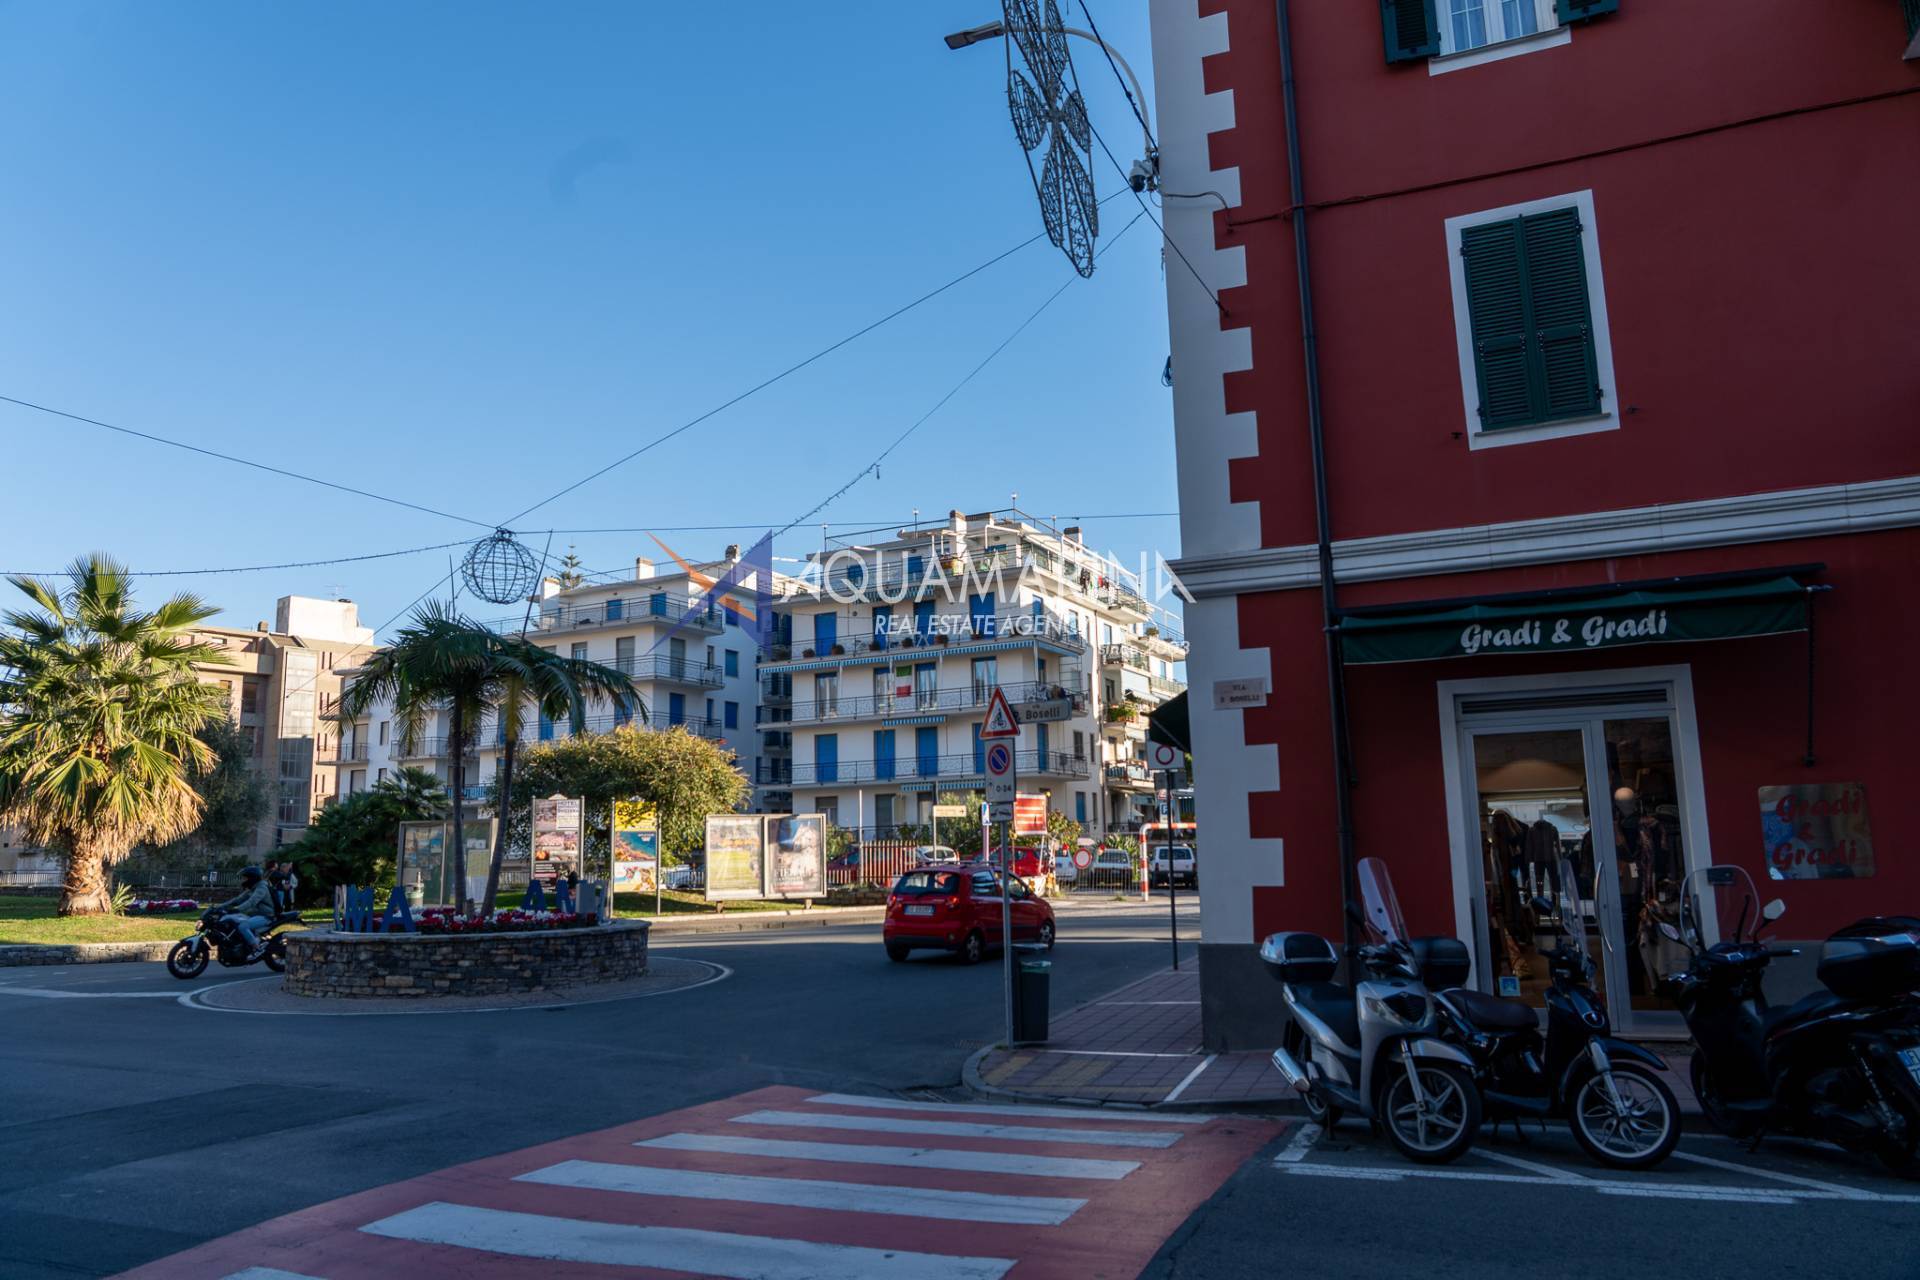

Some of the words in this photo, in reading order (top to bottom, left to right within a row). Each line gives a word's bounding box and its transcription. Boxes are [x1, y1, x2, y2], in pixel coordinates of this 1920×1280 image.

[1460, 620, 1541, 653] Gradi
[1551, 618, 1572, 643] &
[1581, 609, 1668, 647] Gradi
[1025, 706, 1060, 720] Boselli
[1775, 789, 1861, 824] Gradi
[1772, 839, 1857, 871] Gradi
